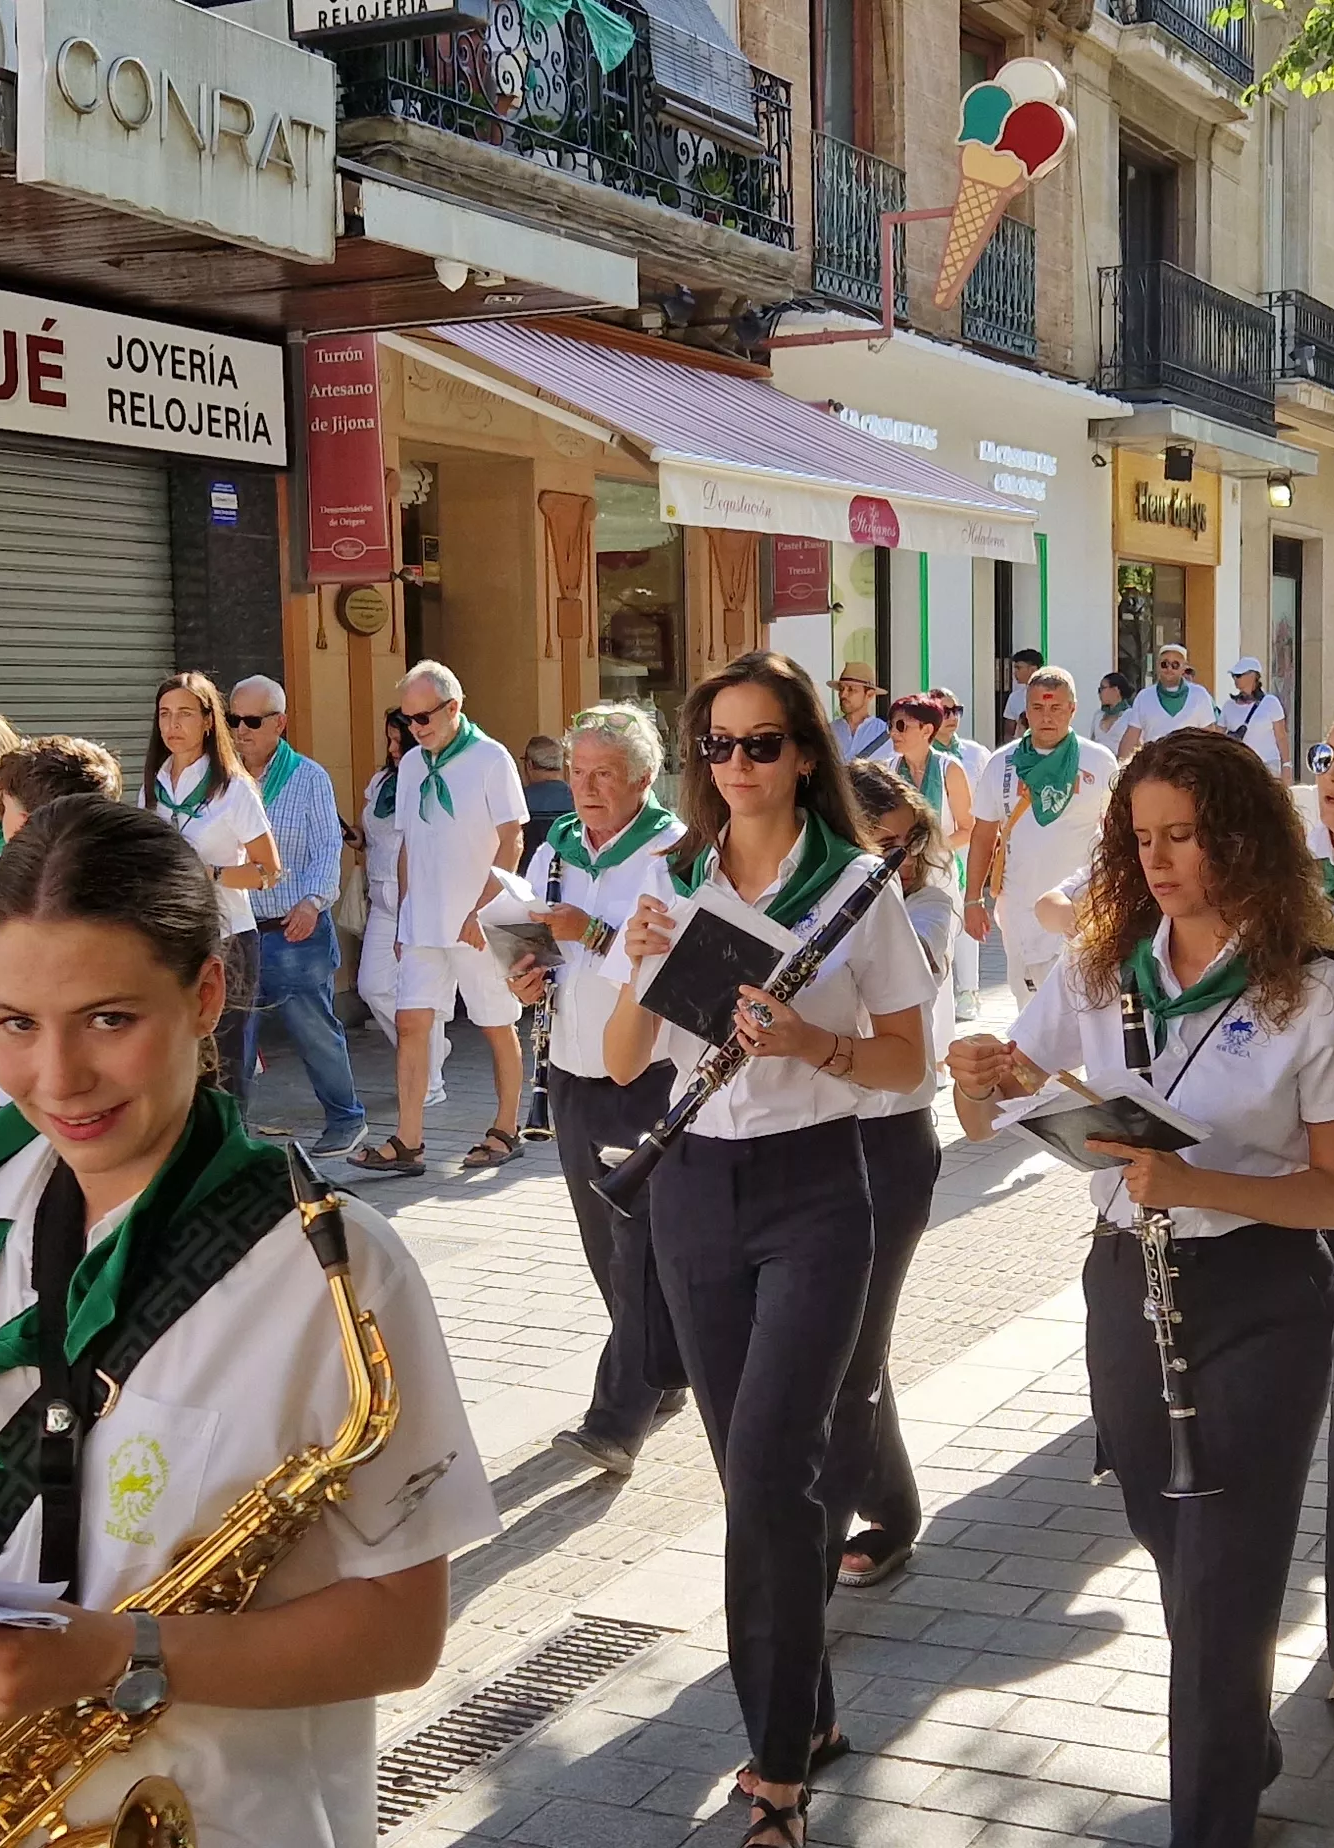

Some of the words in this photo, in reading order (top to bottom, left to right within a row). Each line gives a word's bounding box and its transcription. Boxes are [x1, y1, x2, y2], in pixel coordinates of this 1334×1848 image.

[56, 36, 330, 185] CONRAT
[107, 335, 239, 390] JOYERÍA
[314, 345, 364, 364] Turrón
[308, 383, 374, 399] Artesano
[107, 387, 273, 446] RELOJERÍA
[310, 416, 329, 432] de
[331, 415, 376, 435] Jijona
[320, 503, 373, 514] Denominación
[702, 479, 773, 522] Degustación
[328, 518, 338, 527] de
[339, 516, 366, 528] Origen
[777, 540, 802, 551] Pastel
[804, 539, 826, 549] Ruso
[787, 566, 816, 576] Trenza
